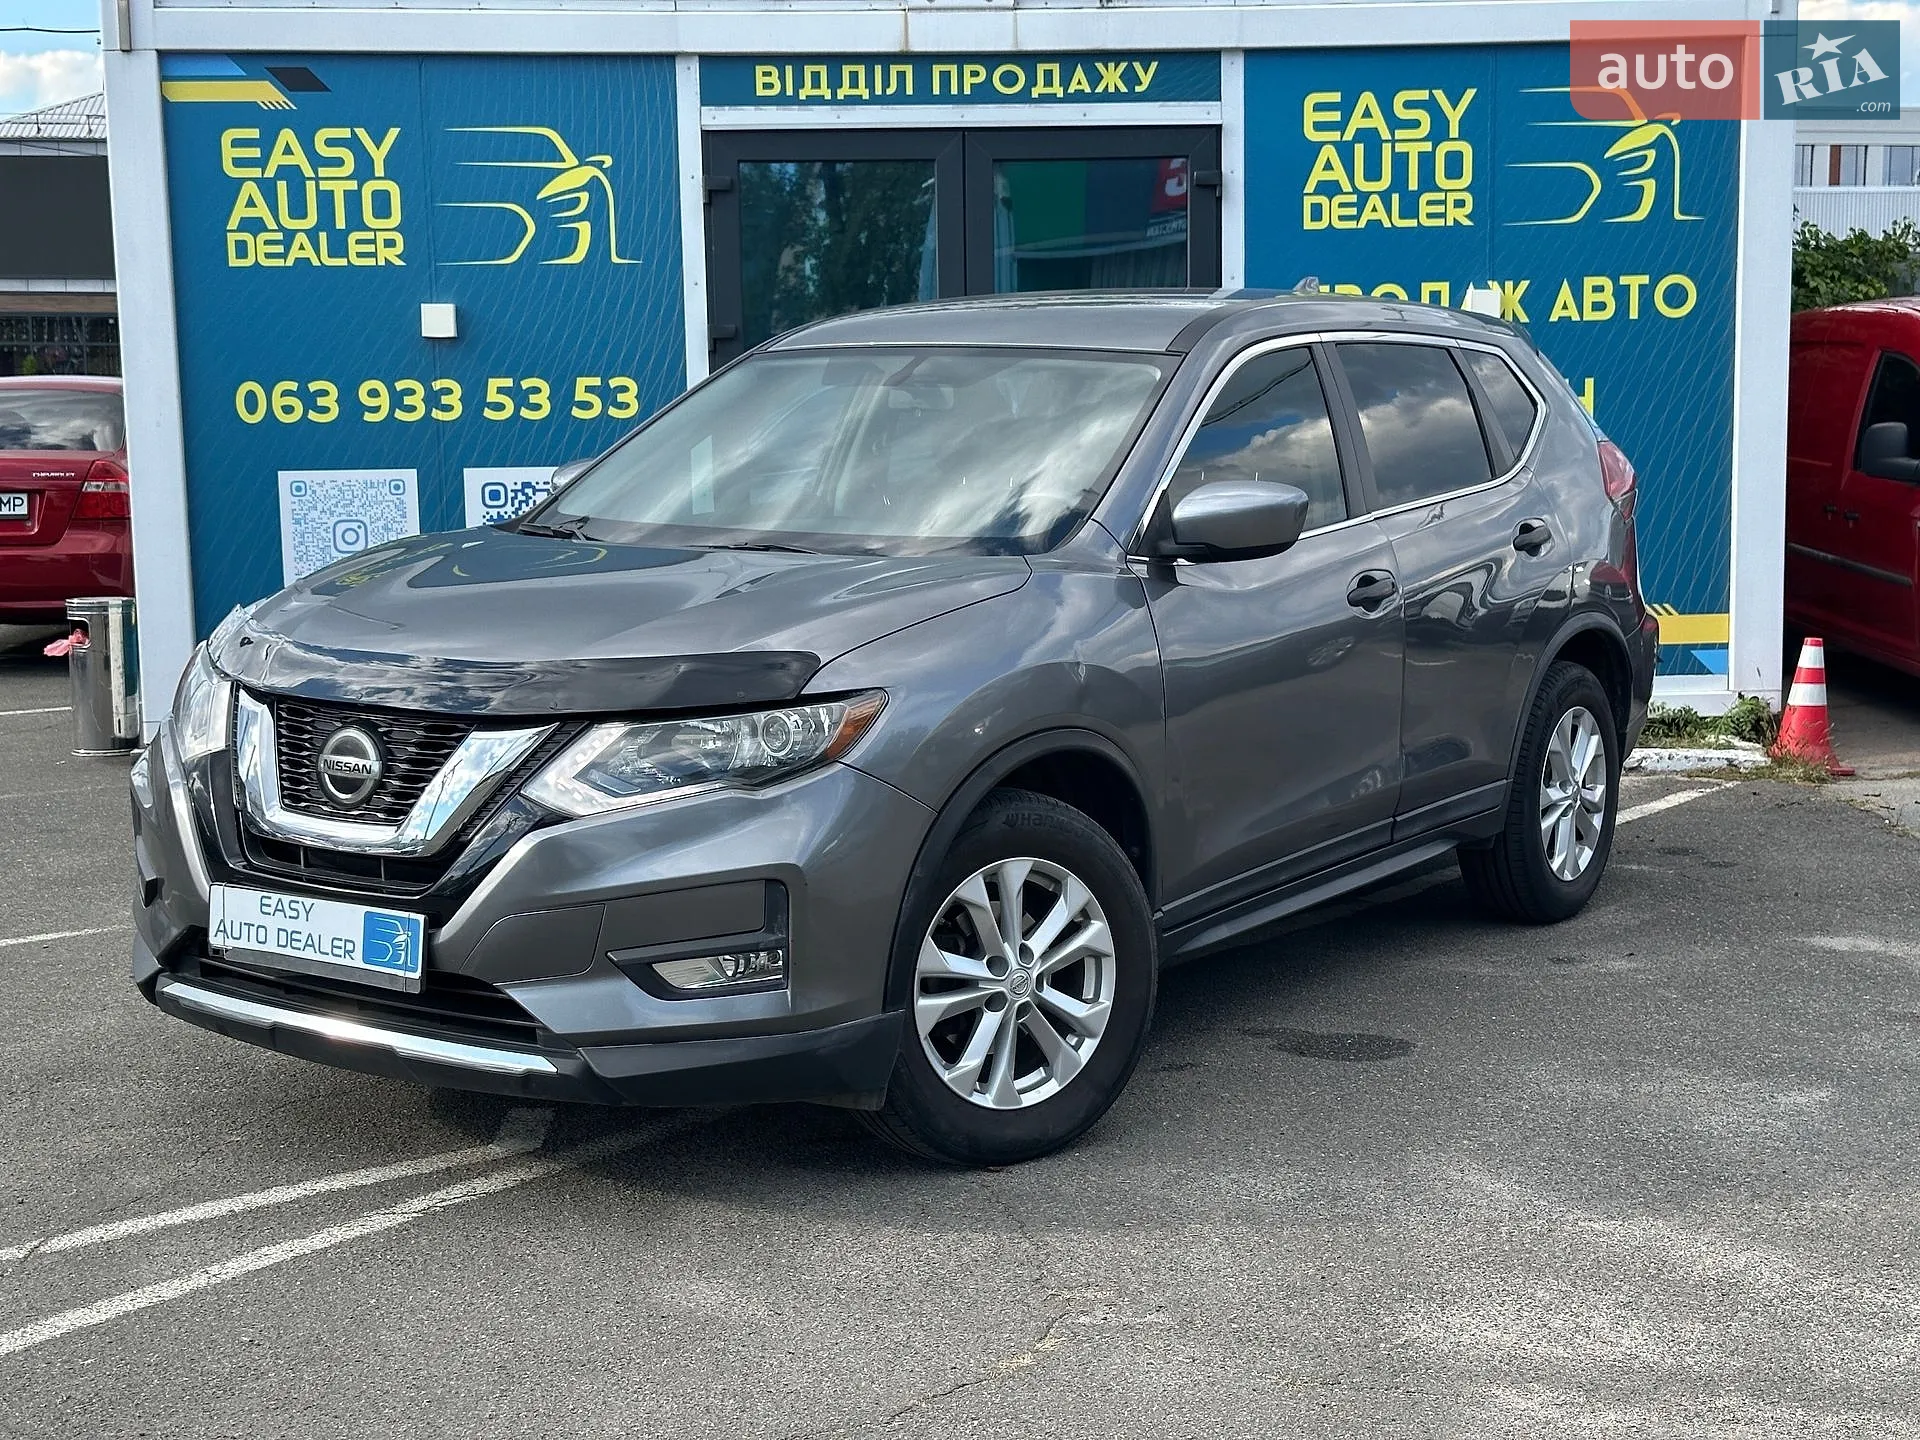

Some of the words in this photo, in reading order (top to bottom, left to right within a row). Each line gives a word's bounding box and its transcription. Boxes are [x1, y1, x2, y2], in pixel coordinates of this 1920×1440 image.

[755, 64, 914, 100] ВІДДІЛ
[932, 61, 1159, 98] ПРОДАЖУ
[1303, 88, 1477, 142] EASY
[221, 127, 401, 178] EASY
[1304, 141, 1474, 193] AUTO
[226, 180, 402, 230] AUTO
[1303, 192, 1474, 230] DEALER
[227, 231, 406, 267] DEALER
[1549, 273, 1698, 322] АВТО
[234, 380, 340, 424] 063
[358, 378, 463, 423] 933
[483, 377, 551, 421] 53
[570, 375, 640, 420] 53
[323, 759, 372, 775] NISSAN
[259, 895, 315, 922] EASY
[214, 919, 268, 945] AUTO
[276, 928, 356, 960] DEALER
